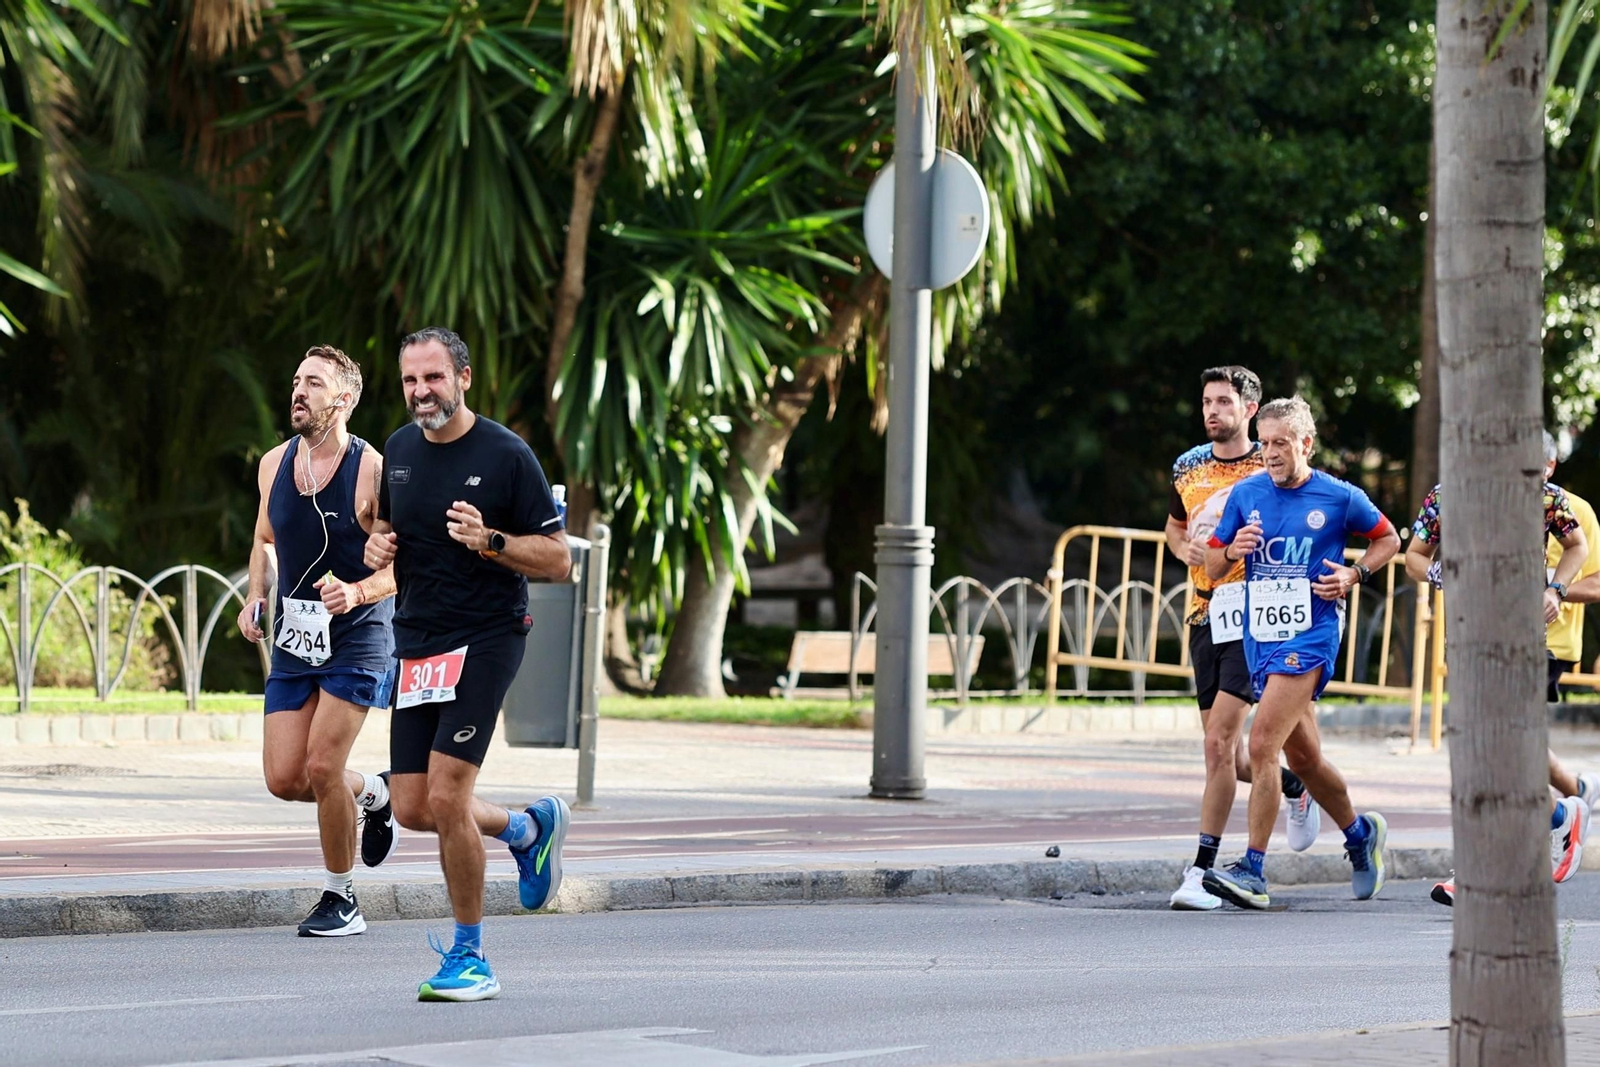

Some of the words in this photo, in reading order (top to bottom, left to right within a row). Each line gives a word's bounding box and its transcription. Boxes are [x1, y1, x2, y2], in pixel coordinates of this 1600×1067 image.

[1252, 535, 1314, 565] RCM
[1218, 609, 1243, 629] 10
[1255, 604, 1306, 626] 7665
[281, 628, 326, 652] 2764
[409, 661, 447, 691] 301
